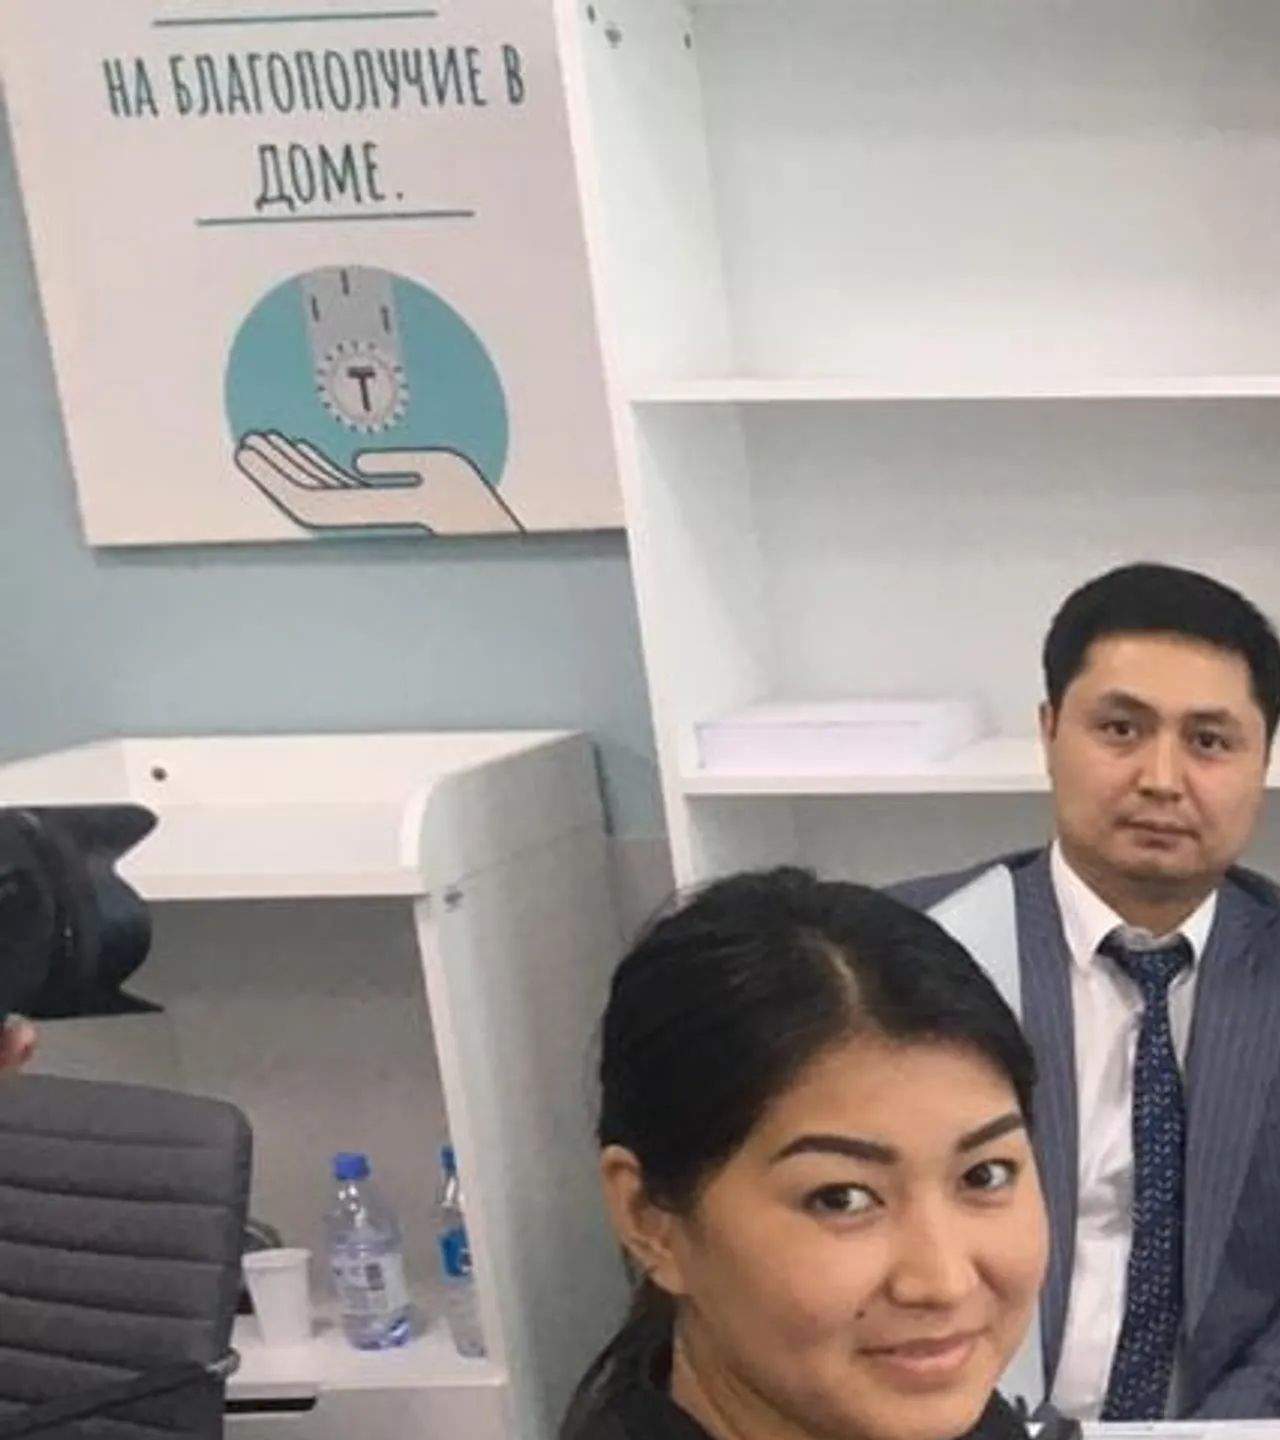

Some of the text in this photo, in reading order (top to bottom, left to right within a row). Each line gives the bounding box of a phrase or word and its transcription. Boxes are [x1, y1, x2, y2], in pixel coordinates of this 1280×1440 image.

[103, 43, 526, 118] НА БЛАГОПОЛУЧИЕ В
[254, 141, 405, 212] ДОМЕ.
